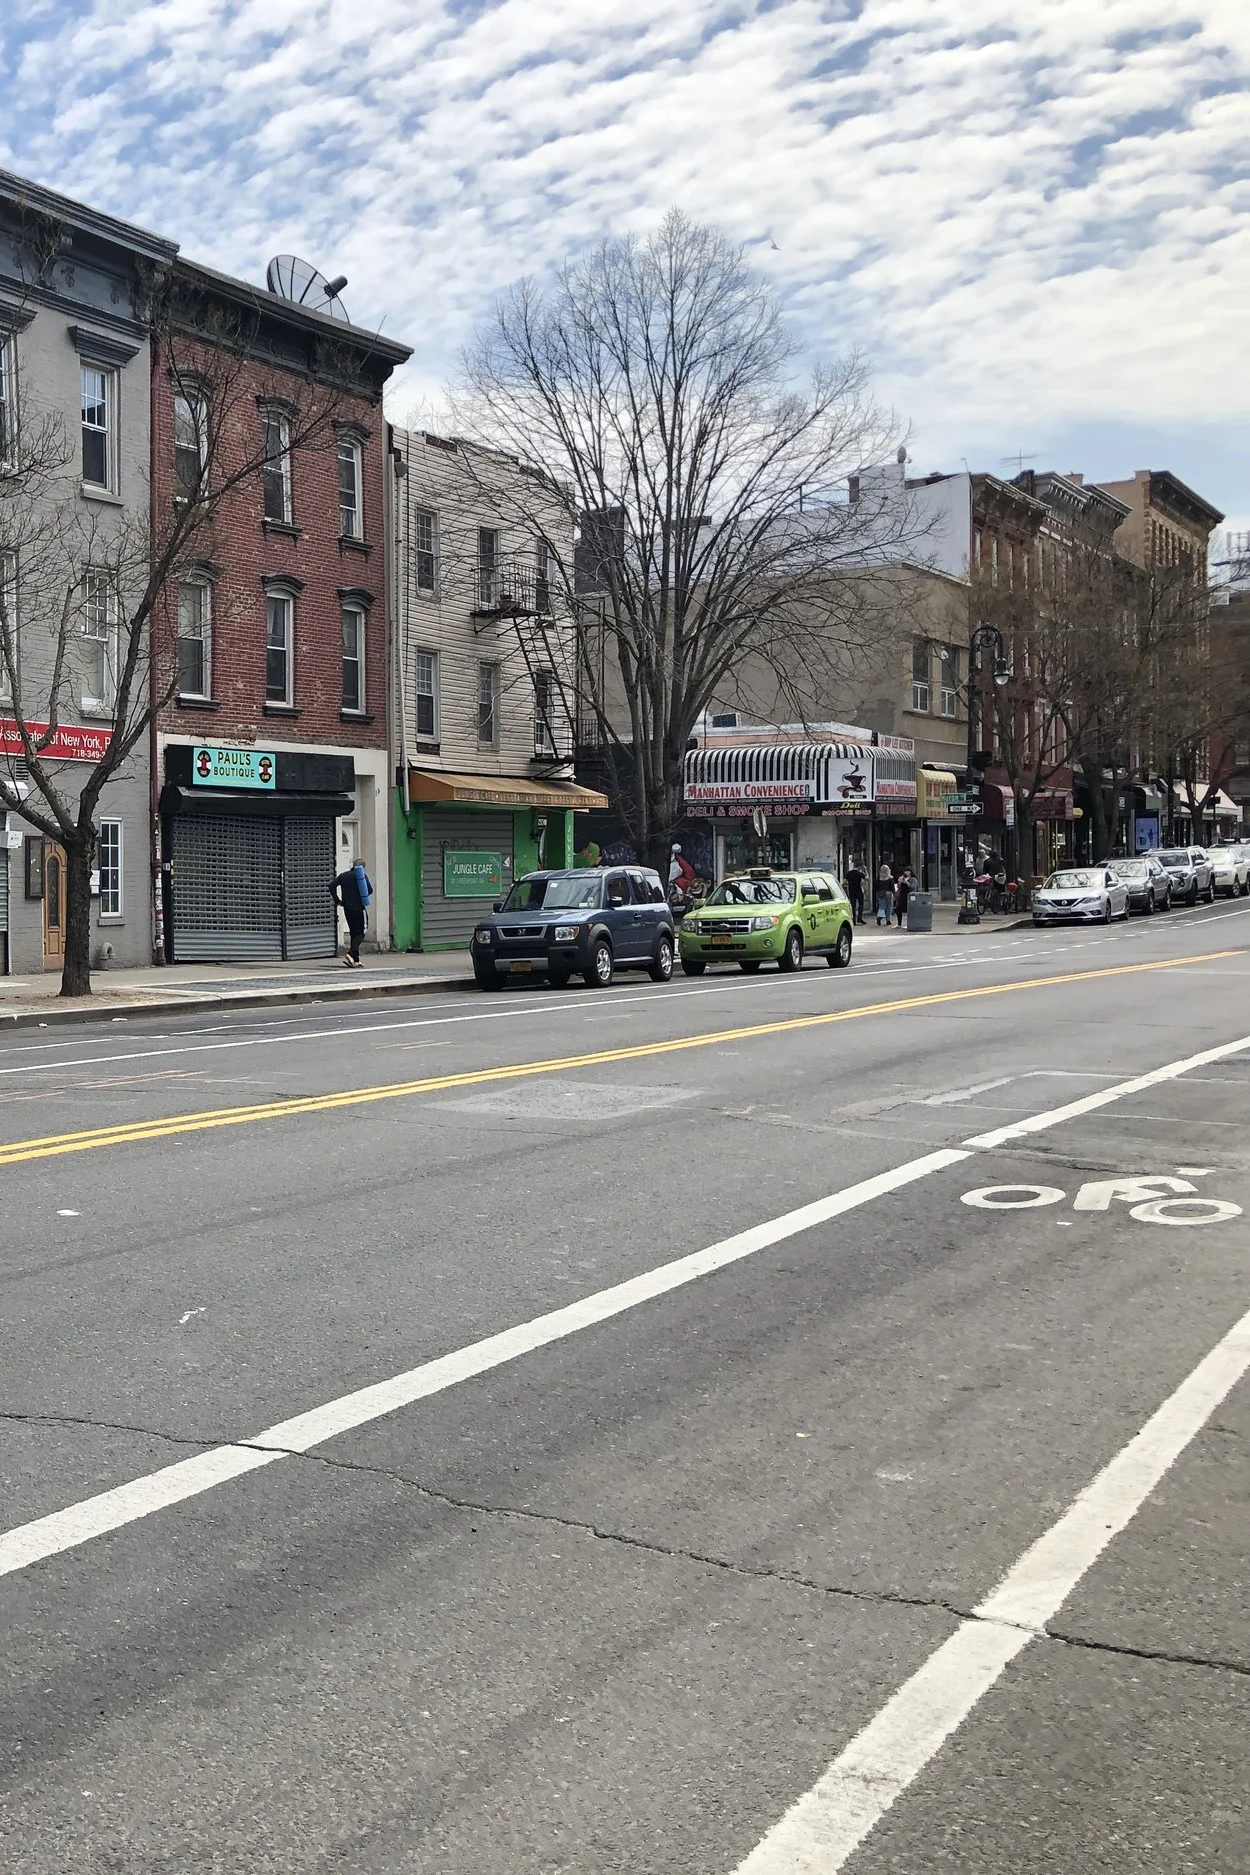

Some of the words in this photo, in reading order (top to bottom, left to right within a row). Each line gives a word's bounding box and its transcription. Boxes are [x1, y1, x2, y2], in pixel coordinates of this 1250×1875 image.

[60, 732, 80, 746] New
[81, 734, 103, 751] York,
[217, 751, 251, 766] PAUL'S
[213, 767, 255, 778] BOUTIQUE
[456, 788, 480, 800] JUNGLE
[687, 784, 741, 798] MANHATTAN
[743, 783, 805, 797] CONVENIENCE
[686, 806, 714, 818] DELI
[716, 805, 726, 817] &
[774, 804, 810, 816] SHOP
[452, 863, 477, 875] JUNGLE
[477, 863, 493, 875] CAFE
